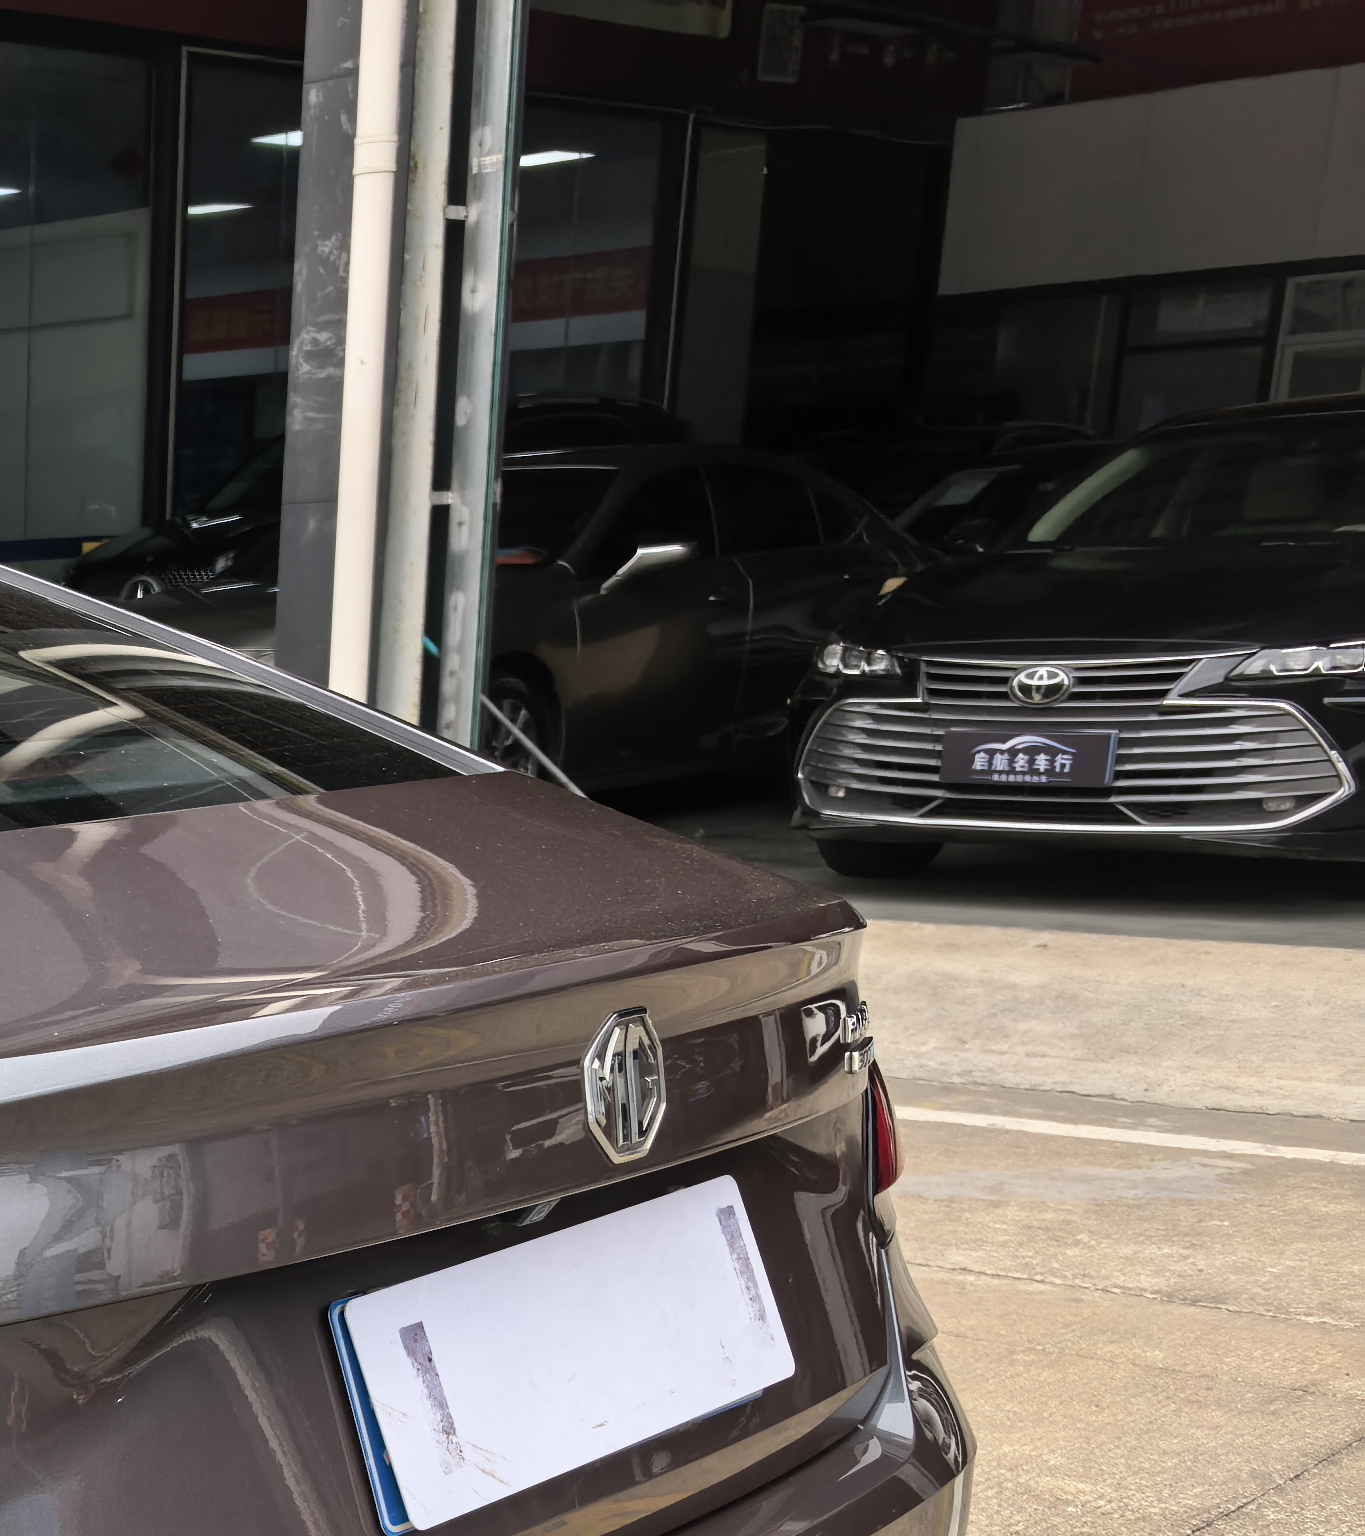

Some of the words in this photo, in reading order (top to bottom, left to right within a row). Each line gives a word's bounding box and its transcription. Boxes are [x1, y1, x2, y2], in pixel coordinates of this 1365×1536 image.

[972, 751, 1074, 773] 启航名车行
[589, 1018, 662, 1152] MG
